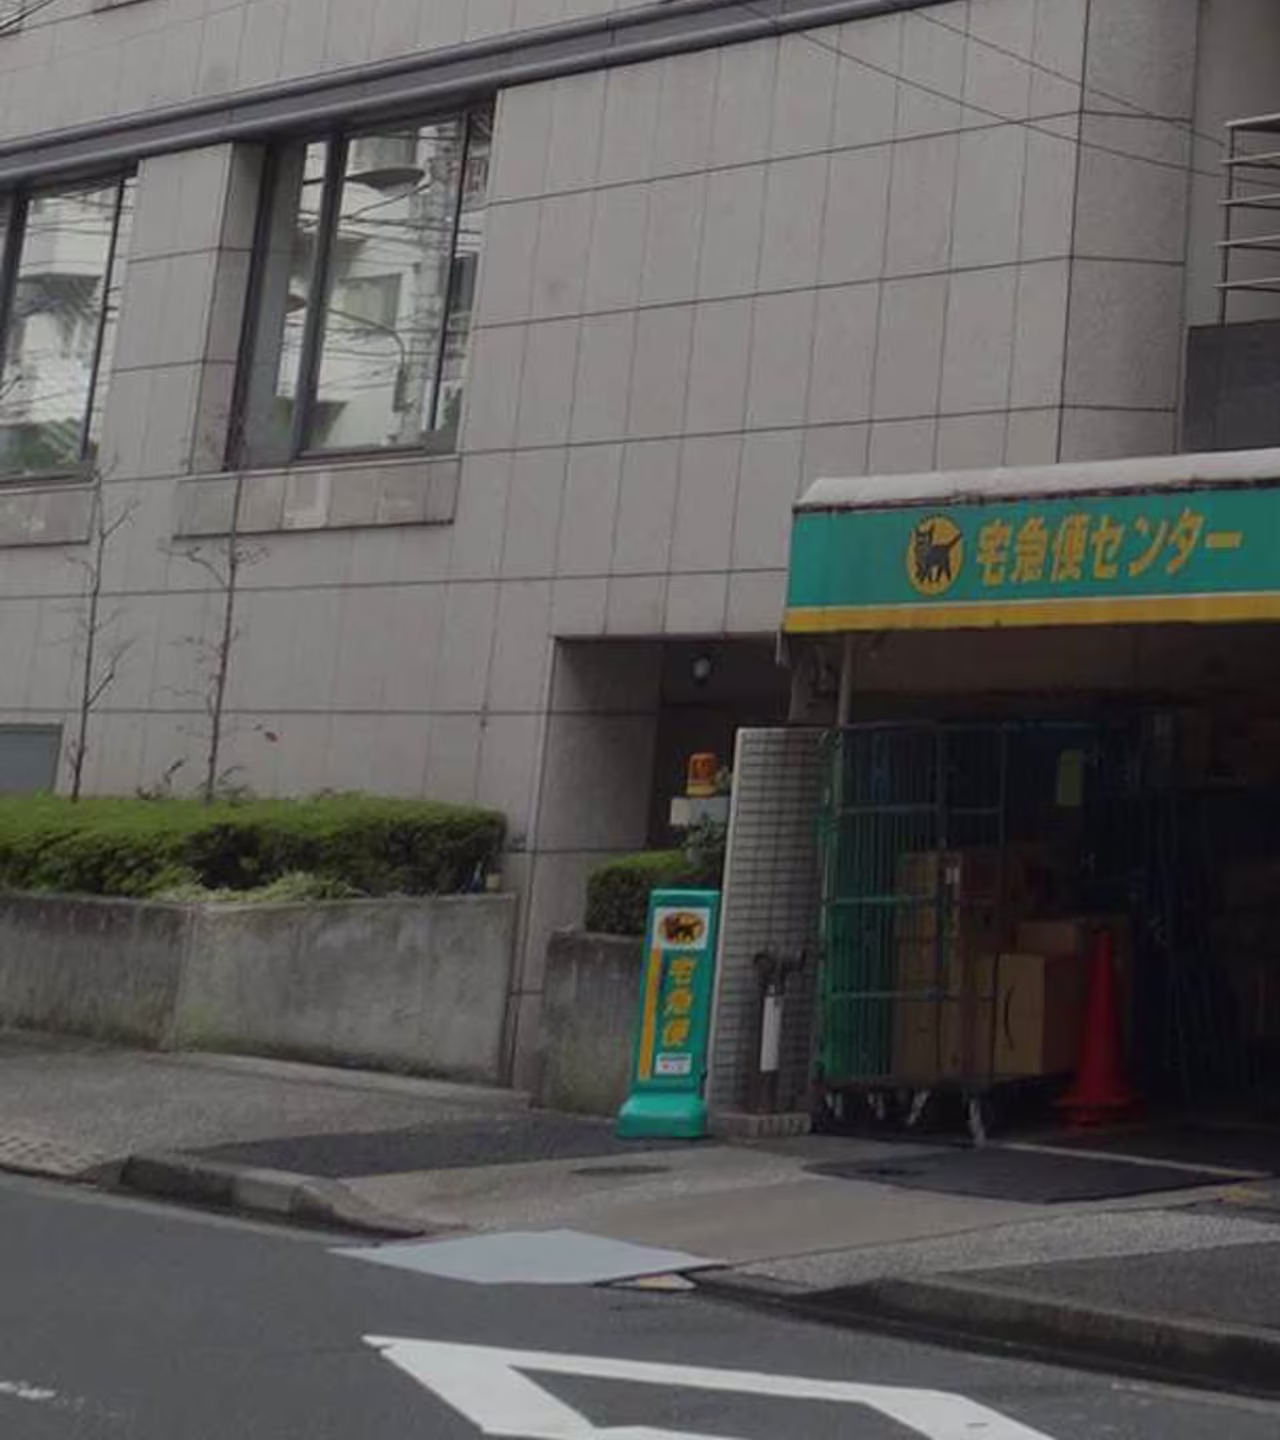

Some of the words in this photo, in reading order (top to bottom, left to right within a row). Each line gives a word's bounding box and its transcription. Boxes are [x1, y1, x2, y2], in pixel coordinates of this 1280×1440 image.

[976, 507, 1243, 586] 宅急便センター
